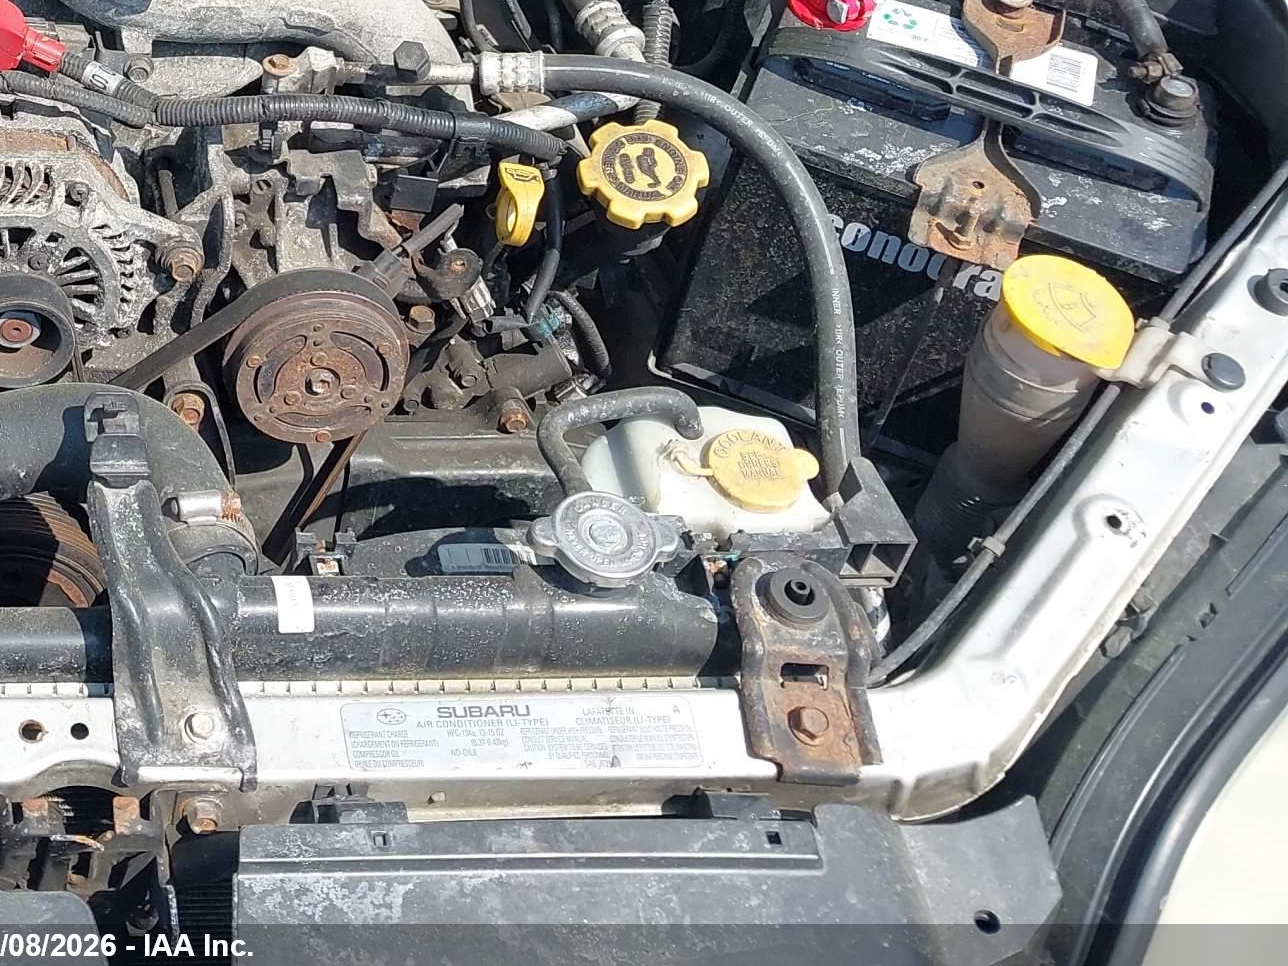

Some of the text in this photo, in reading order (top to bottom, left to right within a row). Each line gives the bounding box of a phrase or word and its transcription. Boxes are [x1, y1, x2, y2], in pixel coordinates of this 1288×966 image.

[831, 288, 841, 315] INNER
[835, 349, 845, 380] OUTER
[713, 430, 787, 458] COOLANT
[436, 704, 531, 719] SUBARU
[575, 715, 632, 726] CLIMATISEUR
[416, 720, 433, 729] AIR
[436, 719, 503, 728] CONDITIONER
